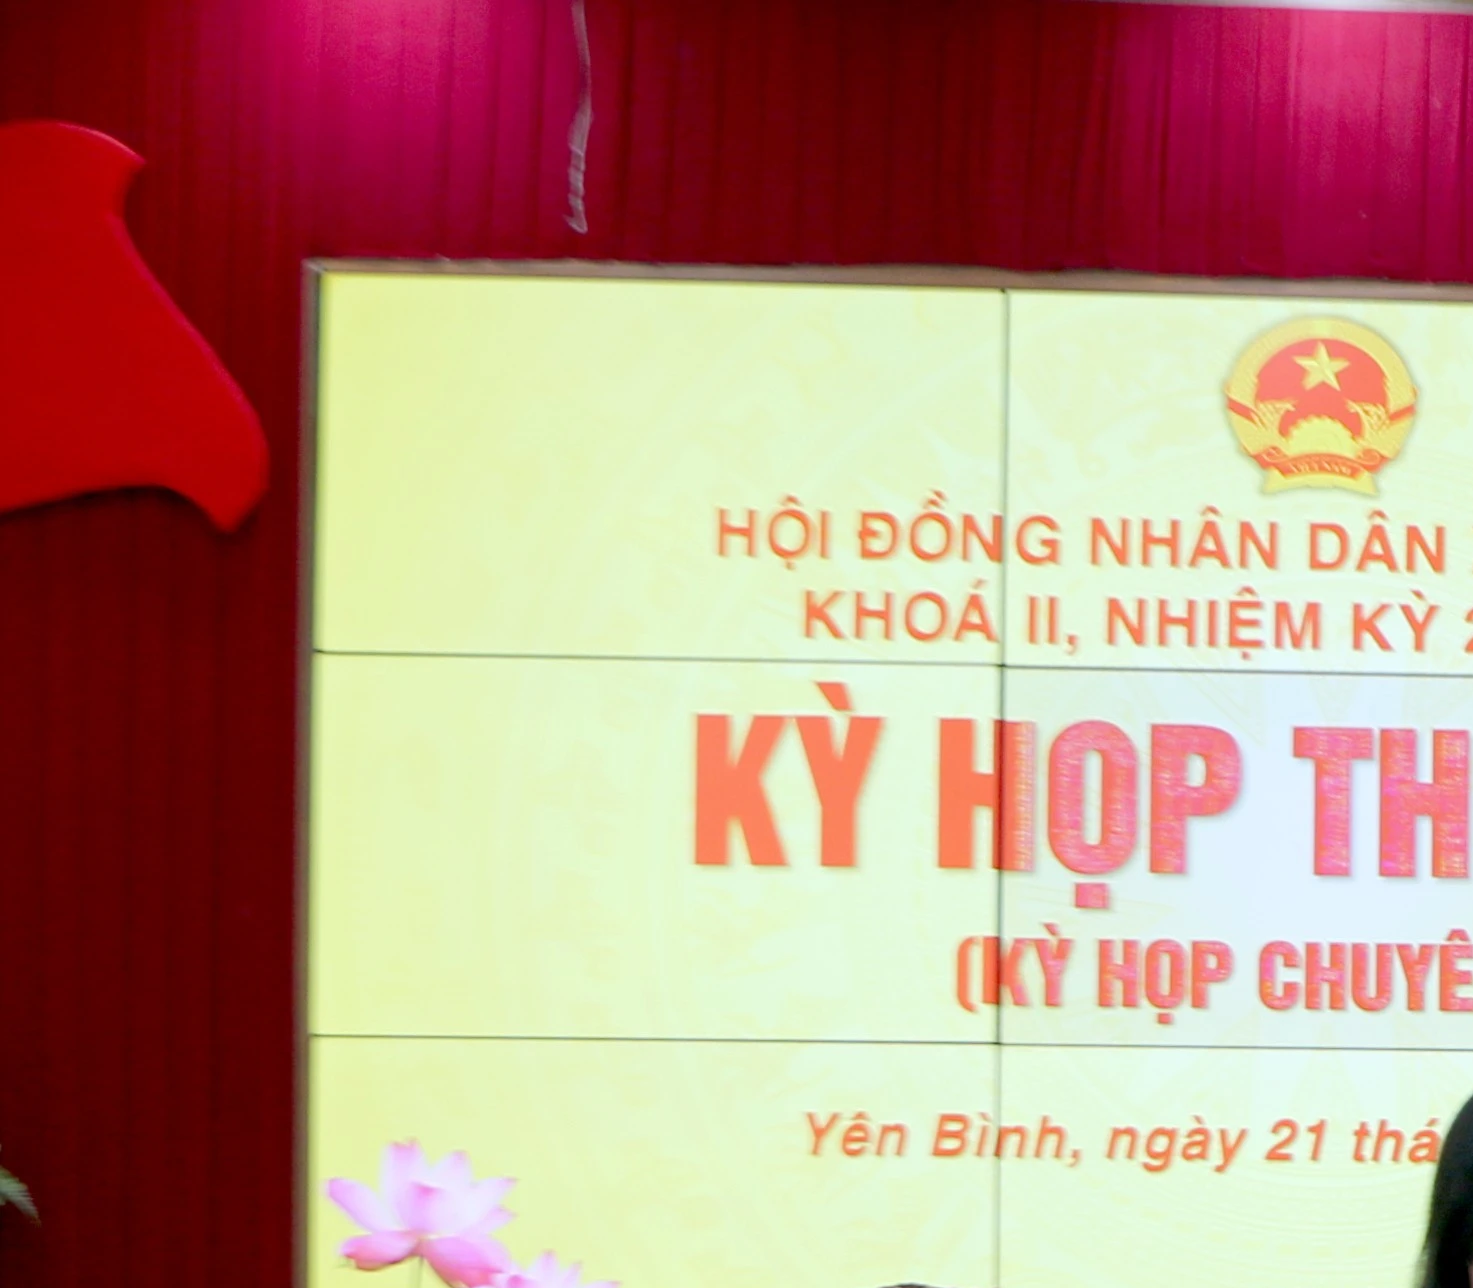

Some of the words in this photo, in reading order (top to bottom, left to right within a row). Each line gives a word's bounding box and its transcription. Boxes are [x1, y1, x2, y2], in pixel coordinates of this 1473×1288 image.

[715, 496, 831, 569] HỘI
[857, 491, 1061, 566] ĐỒNG
[1089, 506, 1278, 570] NHÂN
[1308, 511, 1446, 573] DÂN
[803, 579, 998, 643] KHOÁ
[1026, 594, 1080, 655] II,
[1106, 587, 1322, 660] NHIỆM
[1350, 589, 1440, 652] KỲ
[694, 681, 884, 868] KỲ
[937, 716, 1243, 909] HỌP
[955, 922, 1074, 1014] (KỲ
[1097, 937, 1235, 1025] HỌP
[806, 1112, 908, 1158] Yên
[931, 1112, 1081, 1168] Bình,
[1105, 1114, 1248, 1173] ngày
[1264, 1119, 1328, 1163] 21
[1351, 1116, 1440, 1164] thá
